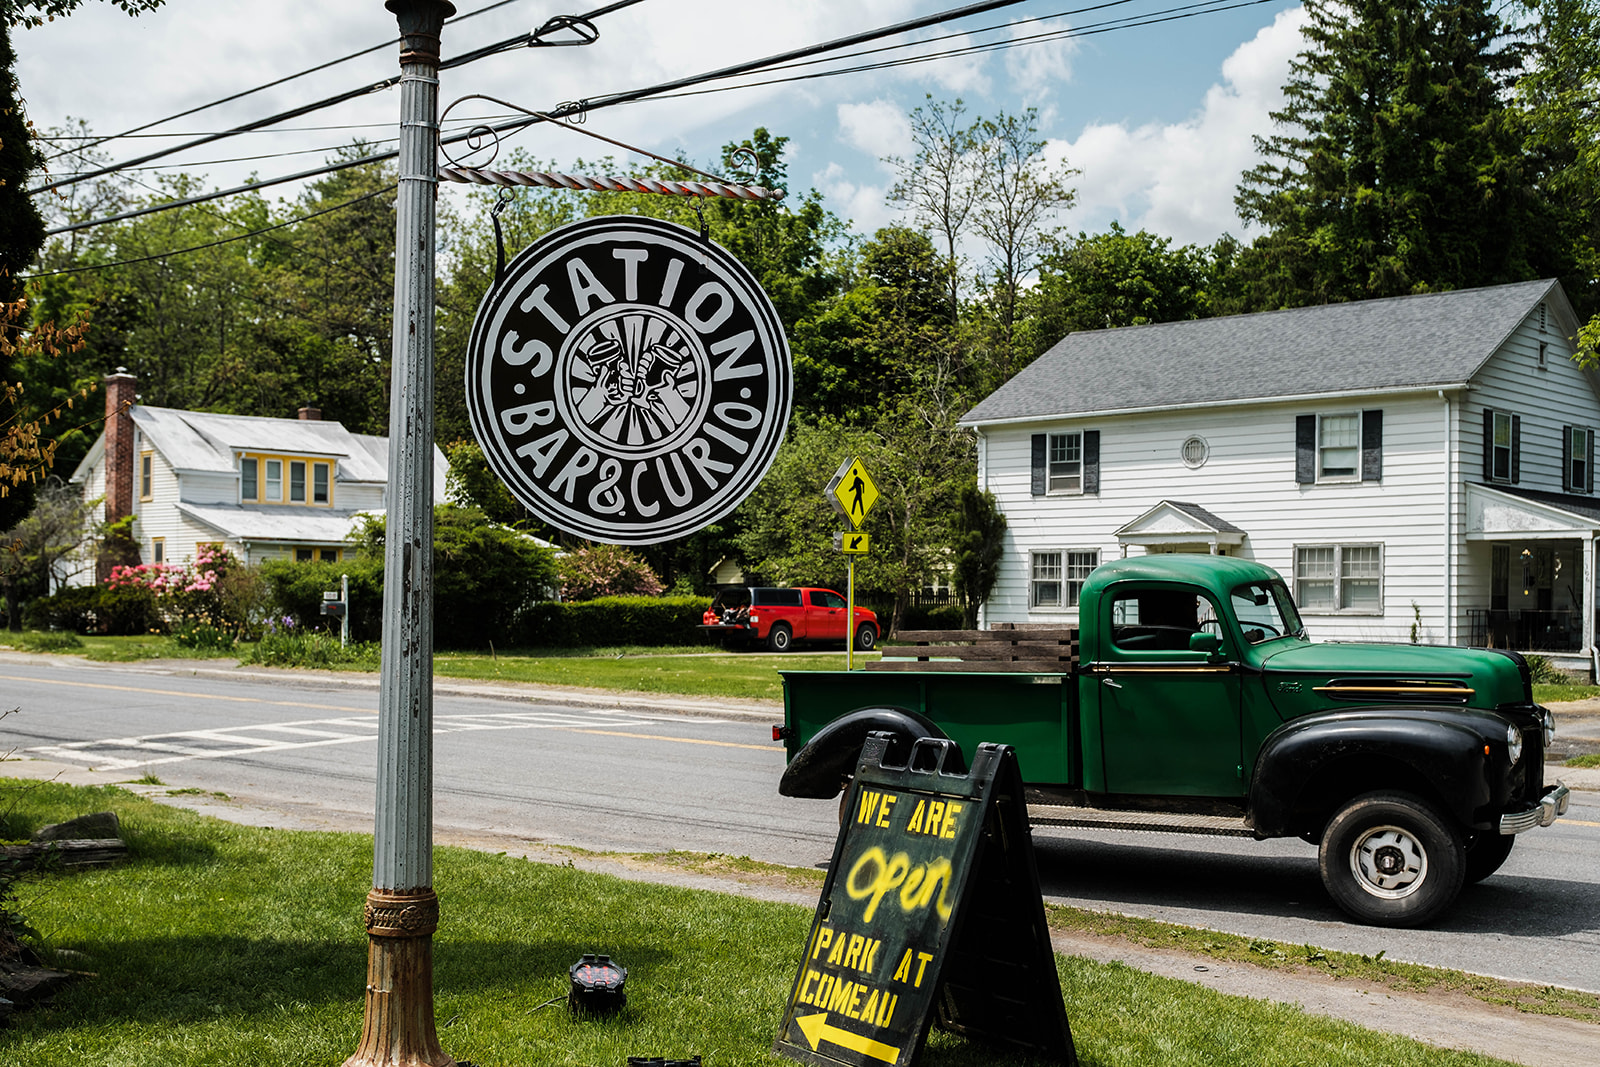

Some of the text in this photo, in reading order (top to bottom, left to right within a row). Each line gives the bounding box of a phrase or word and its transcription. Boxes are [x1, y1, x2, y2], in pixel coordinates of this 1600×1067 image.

[501, 248, 763, 381] STATION
[857, 790, 962, 839] WE ARE
[846, 847, 952, 924] Open
[812, 927, 933, 988] PARK AT
[799, 969, 898, 1028] COMEAU
